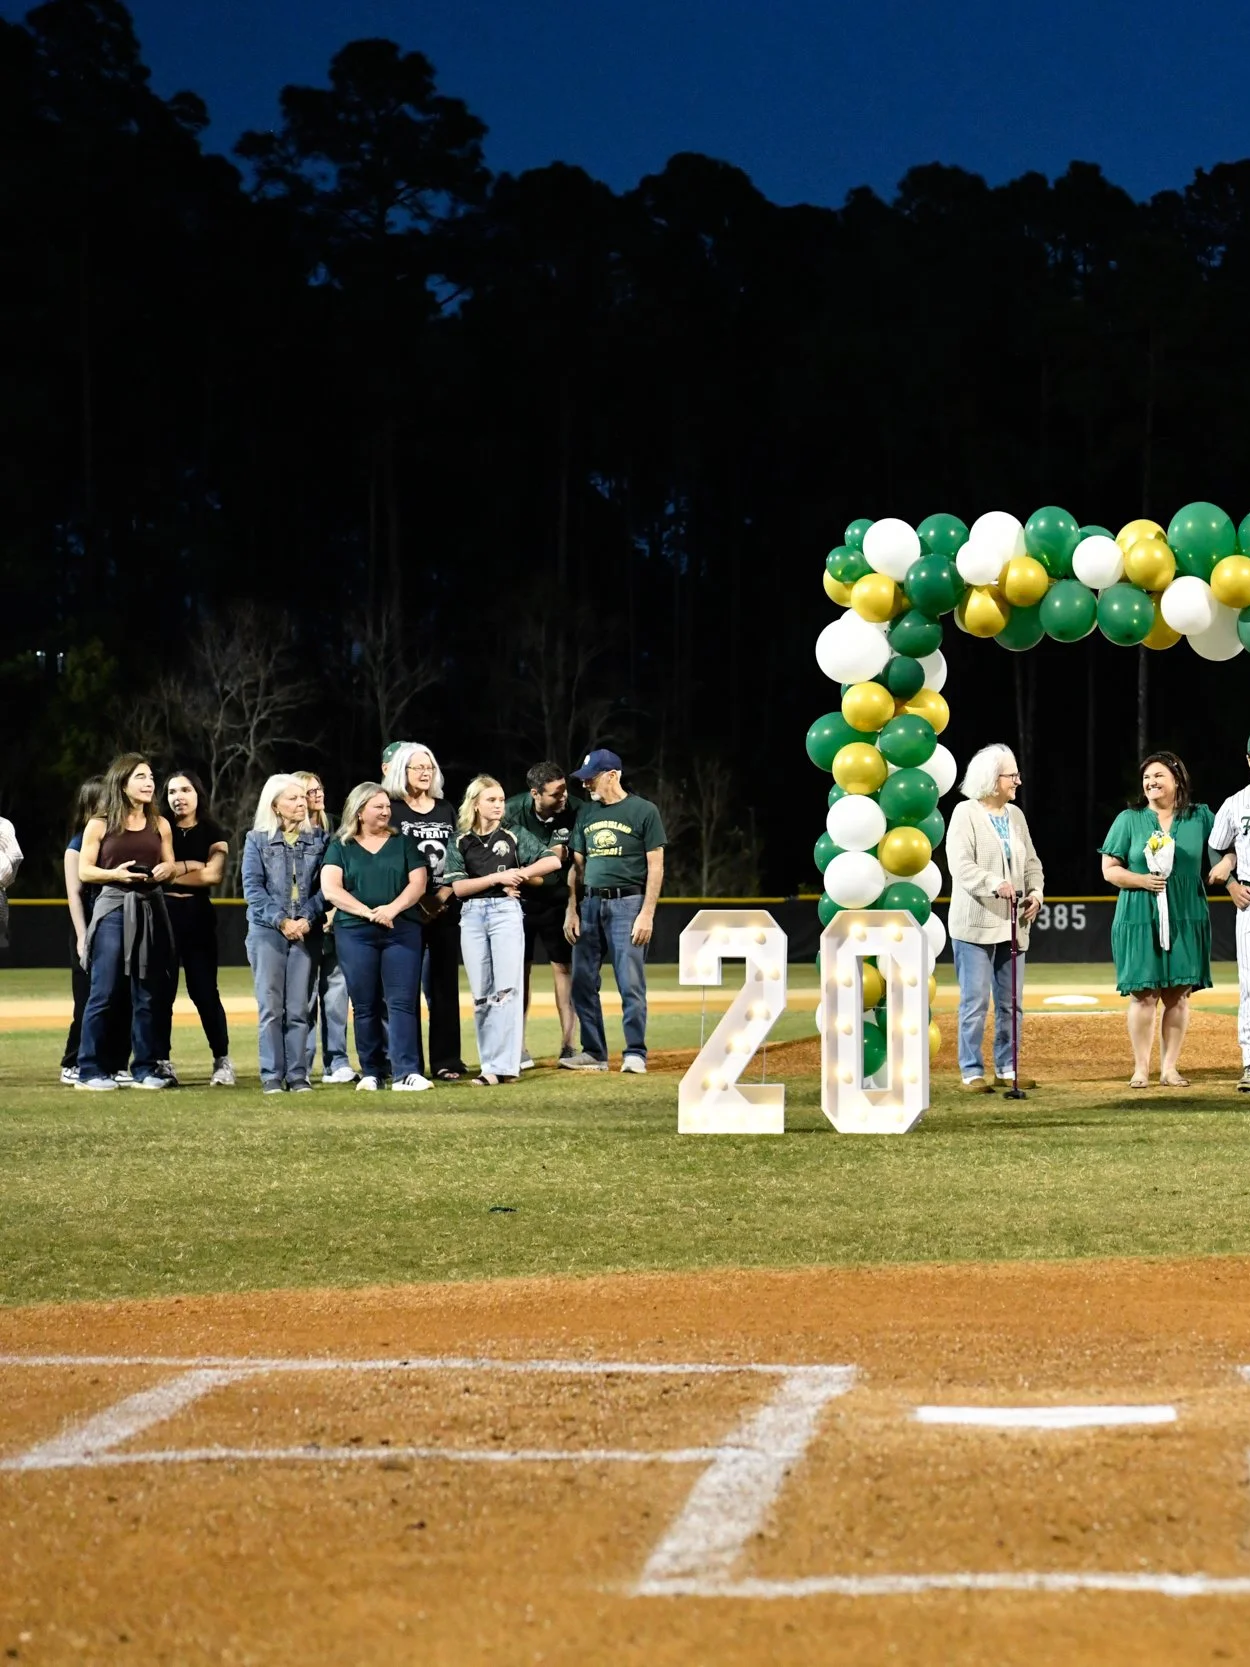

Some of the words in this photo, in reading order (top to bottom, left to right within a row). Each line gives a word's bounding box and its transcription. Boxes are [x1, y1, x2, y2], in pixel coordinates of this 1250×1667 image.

[413, 829, 449, 839] STRAIT
[1037, 904, 1086, 930] 385
[678, 909, 929, 1134] 20
